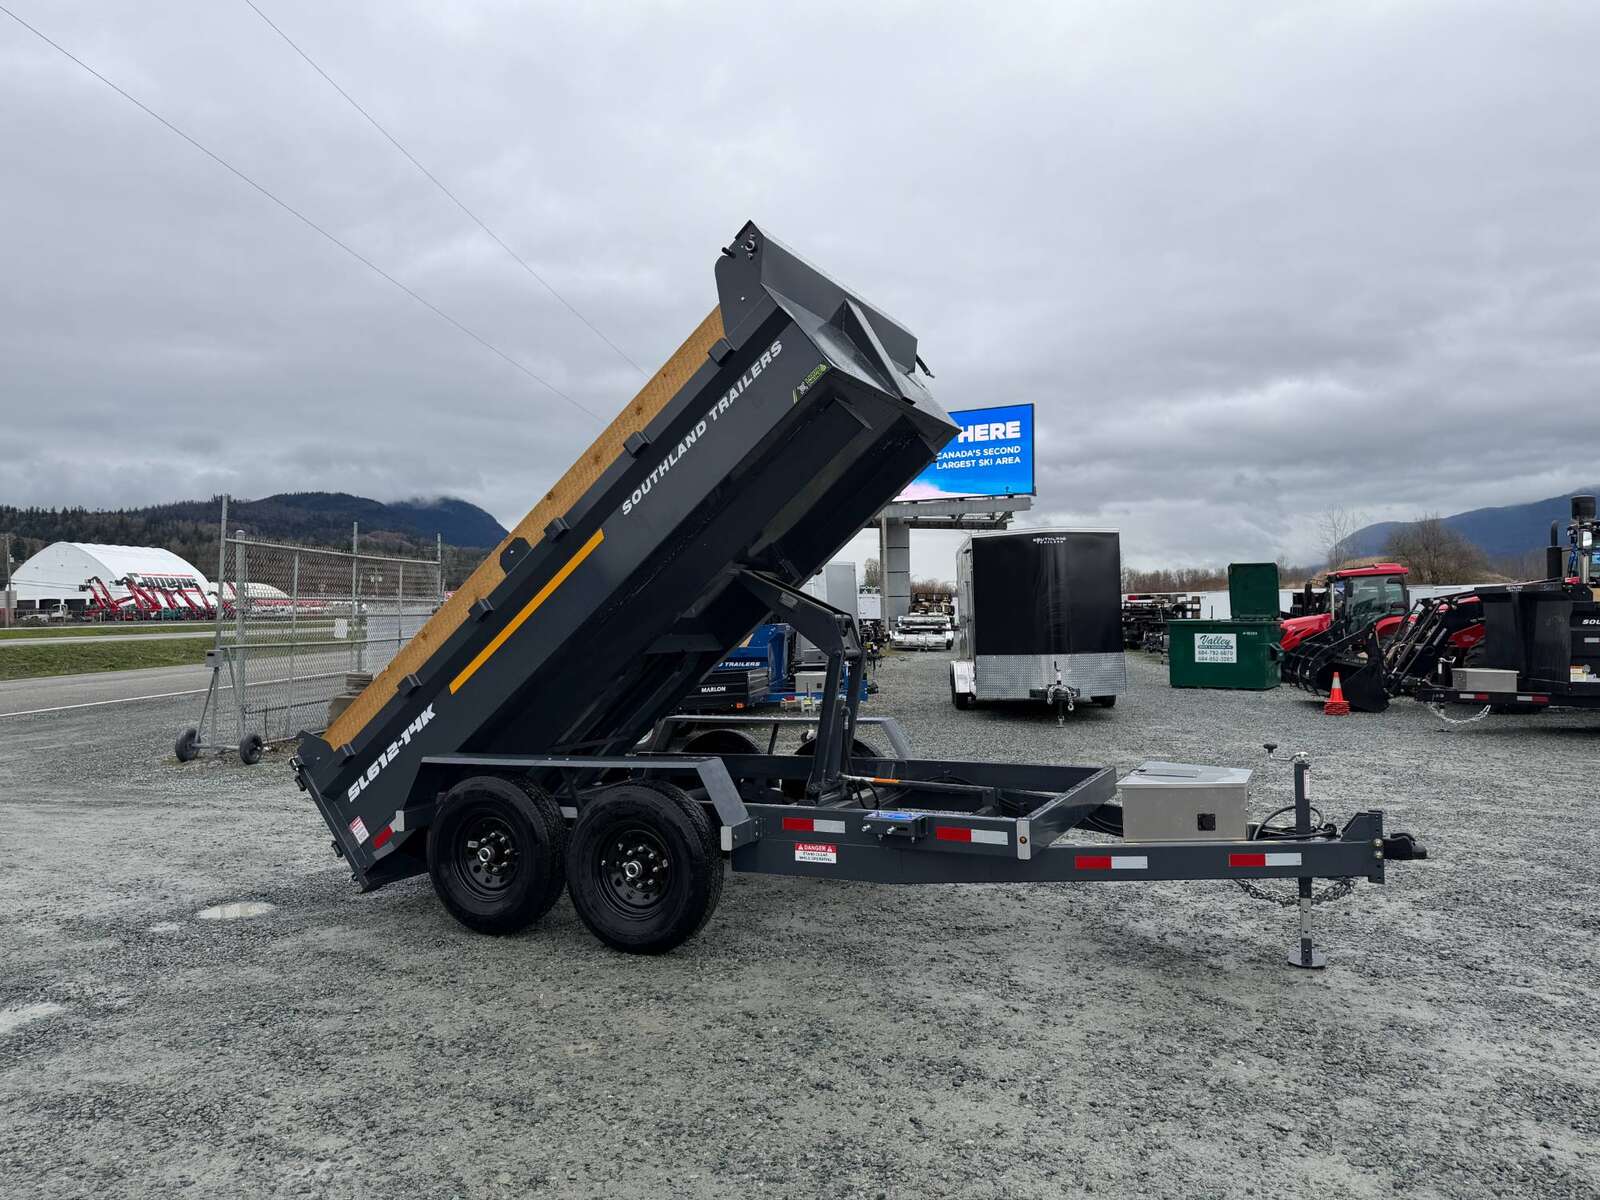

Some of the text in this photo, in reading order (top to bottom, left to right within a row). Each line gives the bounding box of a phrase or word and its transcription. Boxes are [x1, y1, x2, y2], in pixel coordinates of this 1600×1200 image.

[622, 340, 782, 515] SOUTHLAND TRAILERS
[957, 420, 1021, 443] HERE
[936, 446, 1021, 459] CANADA'S SECOND
[936, 456, 1021, 470] LARGEST SKI AREA
[1200, 635, 1231, 646] Valley
[347, 702, 436, 803] SL612-14K
